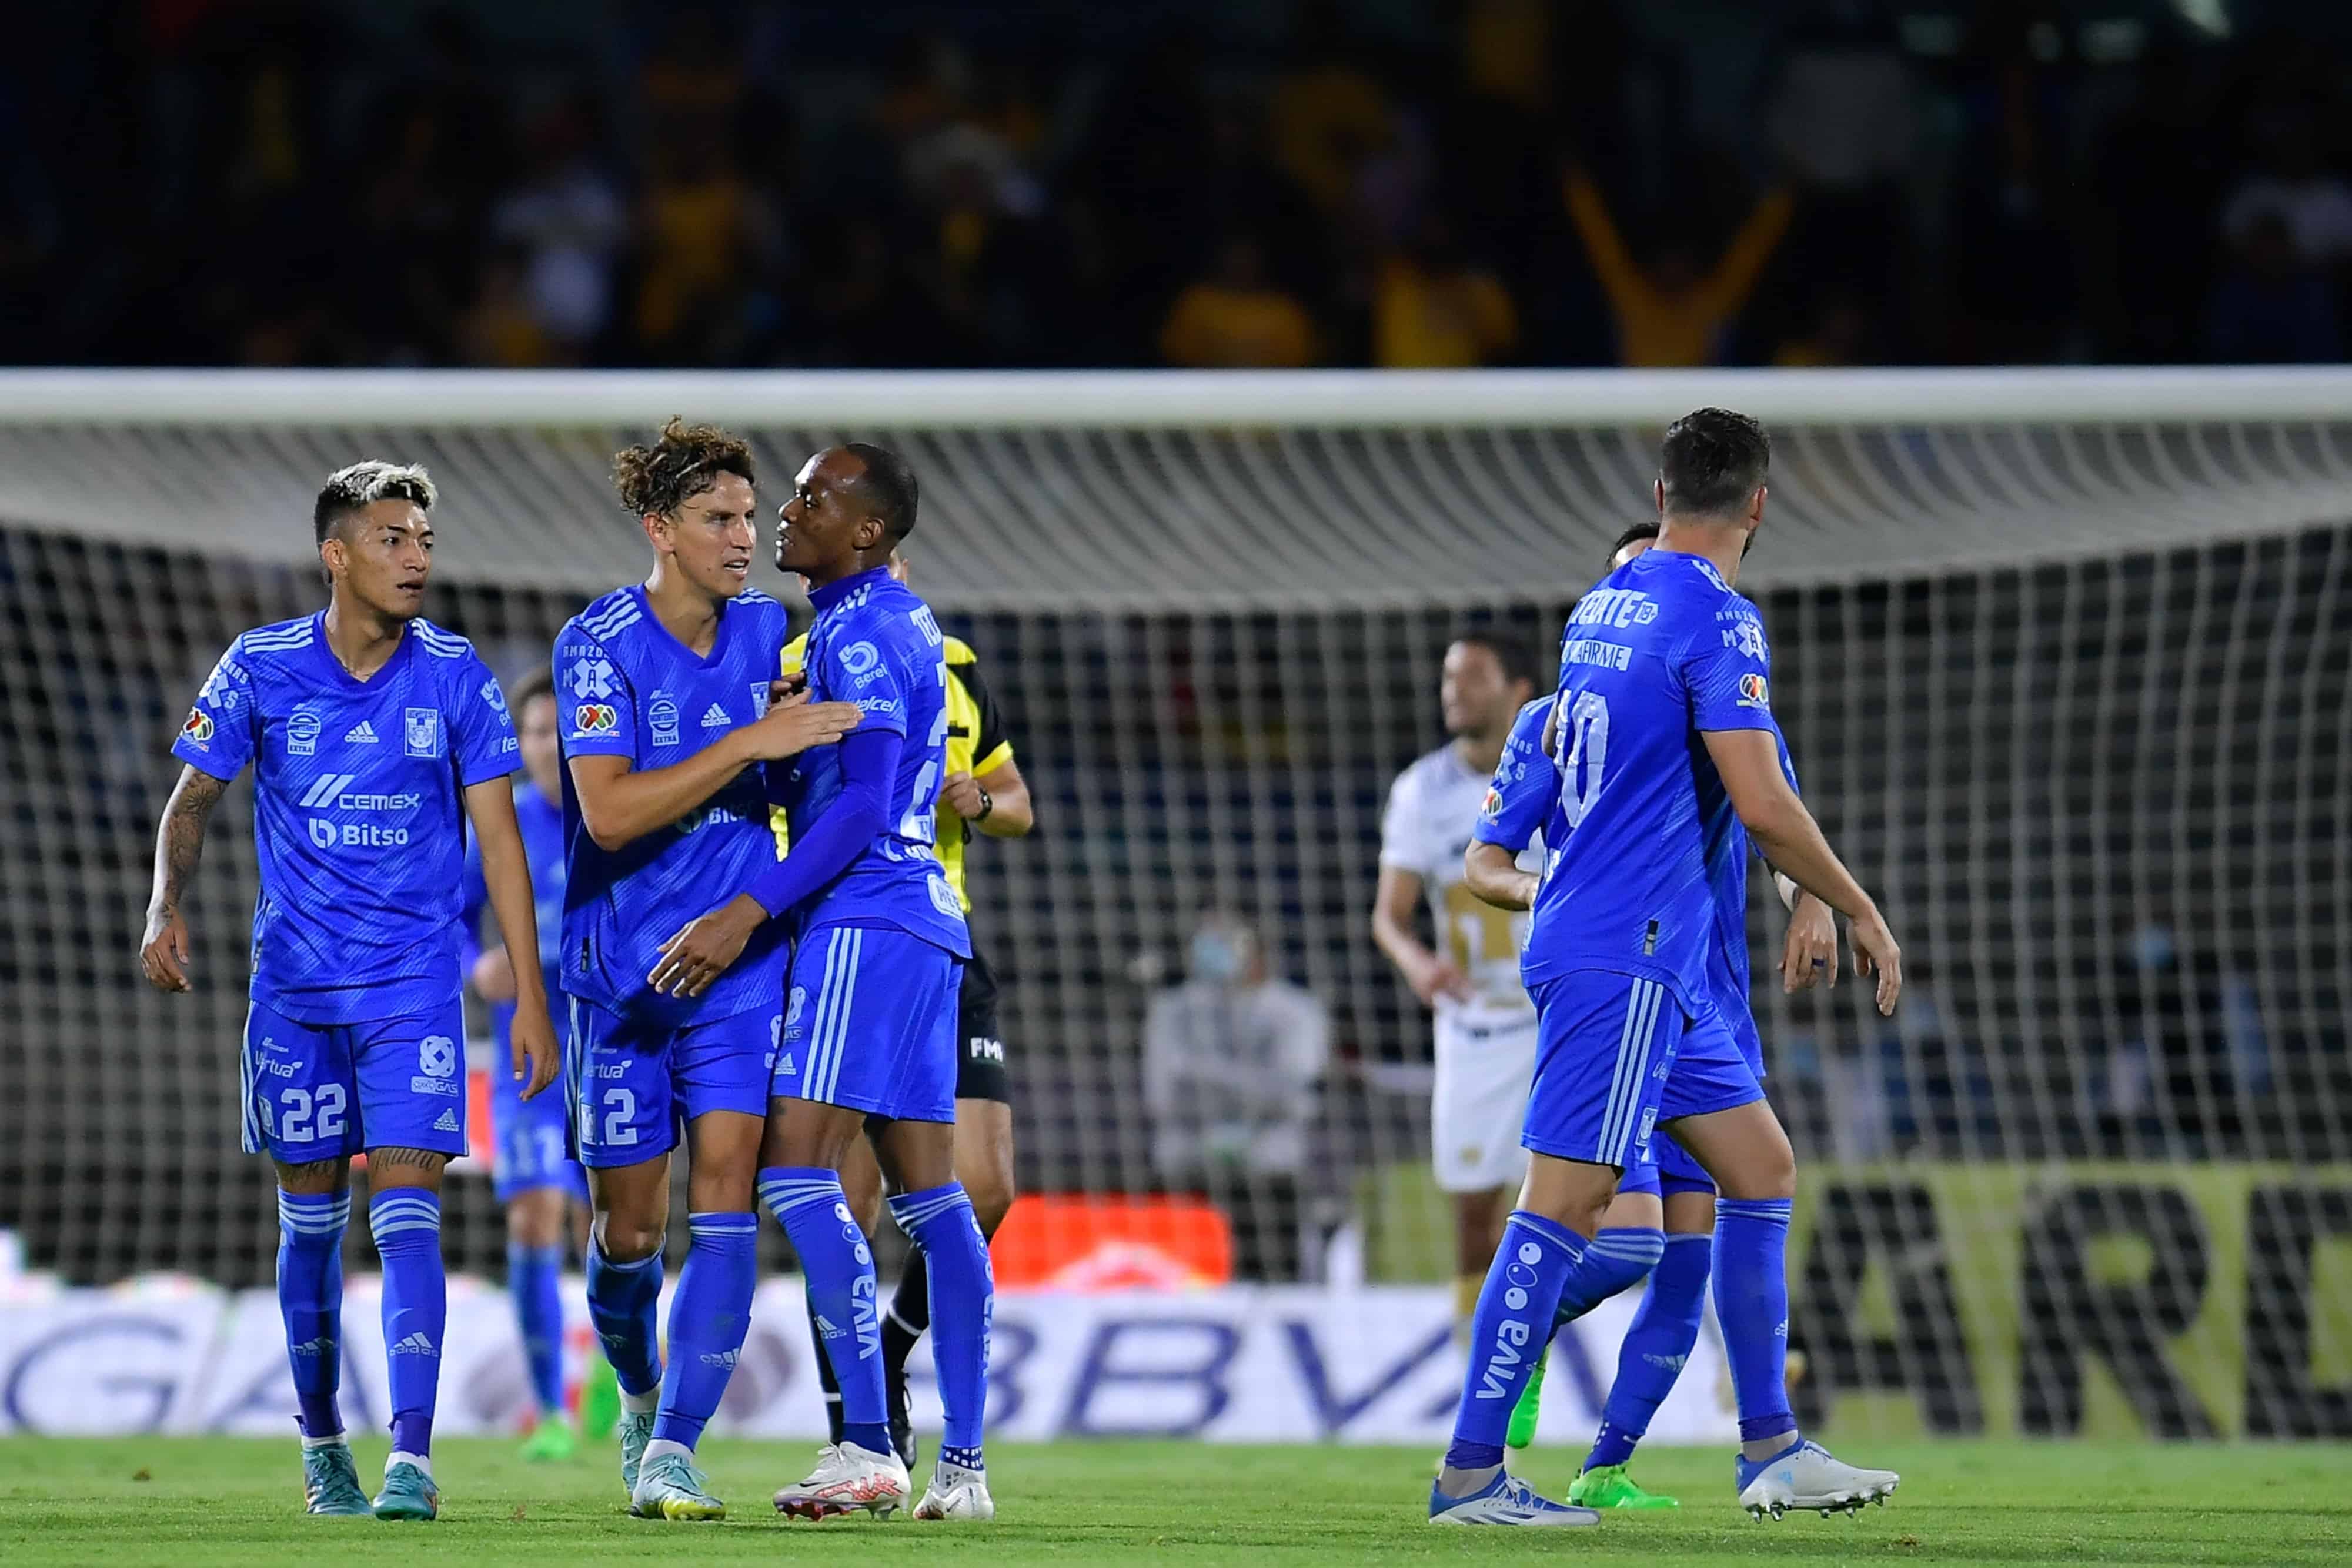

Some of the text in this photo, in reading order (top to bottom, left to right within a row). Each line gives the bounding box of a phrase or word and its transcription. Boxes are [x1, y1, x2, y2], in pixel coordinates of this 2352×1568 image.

[854, 663, 888, 689] Berel
[339, 793, 420, 811] CEMEX
[343, 823, 409, 847] Bitso
[280, 1083, 347, 1142] 22
[603, 1088, 638, 1145] 2
